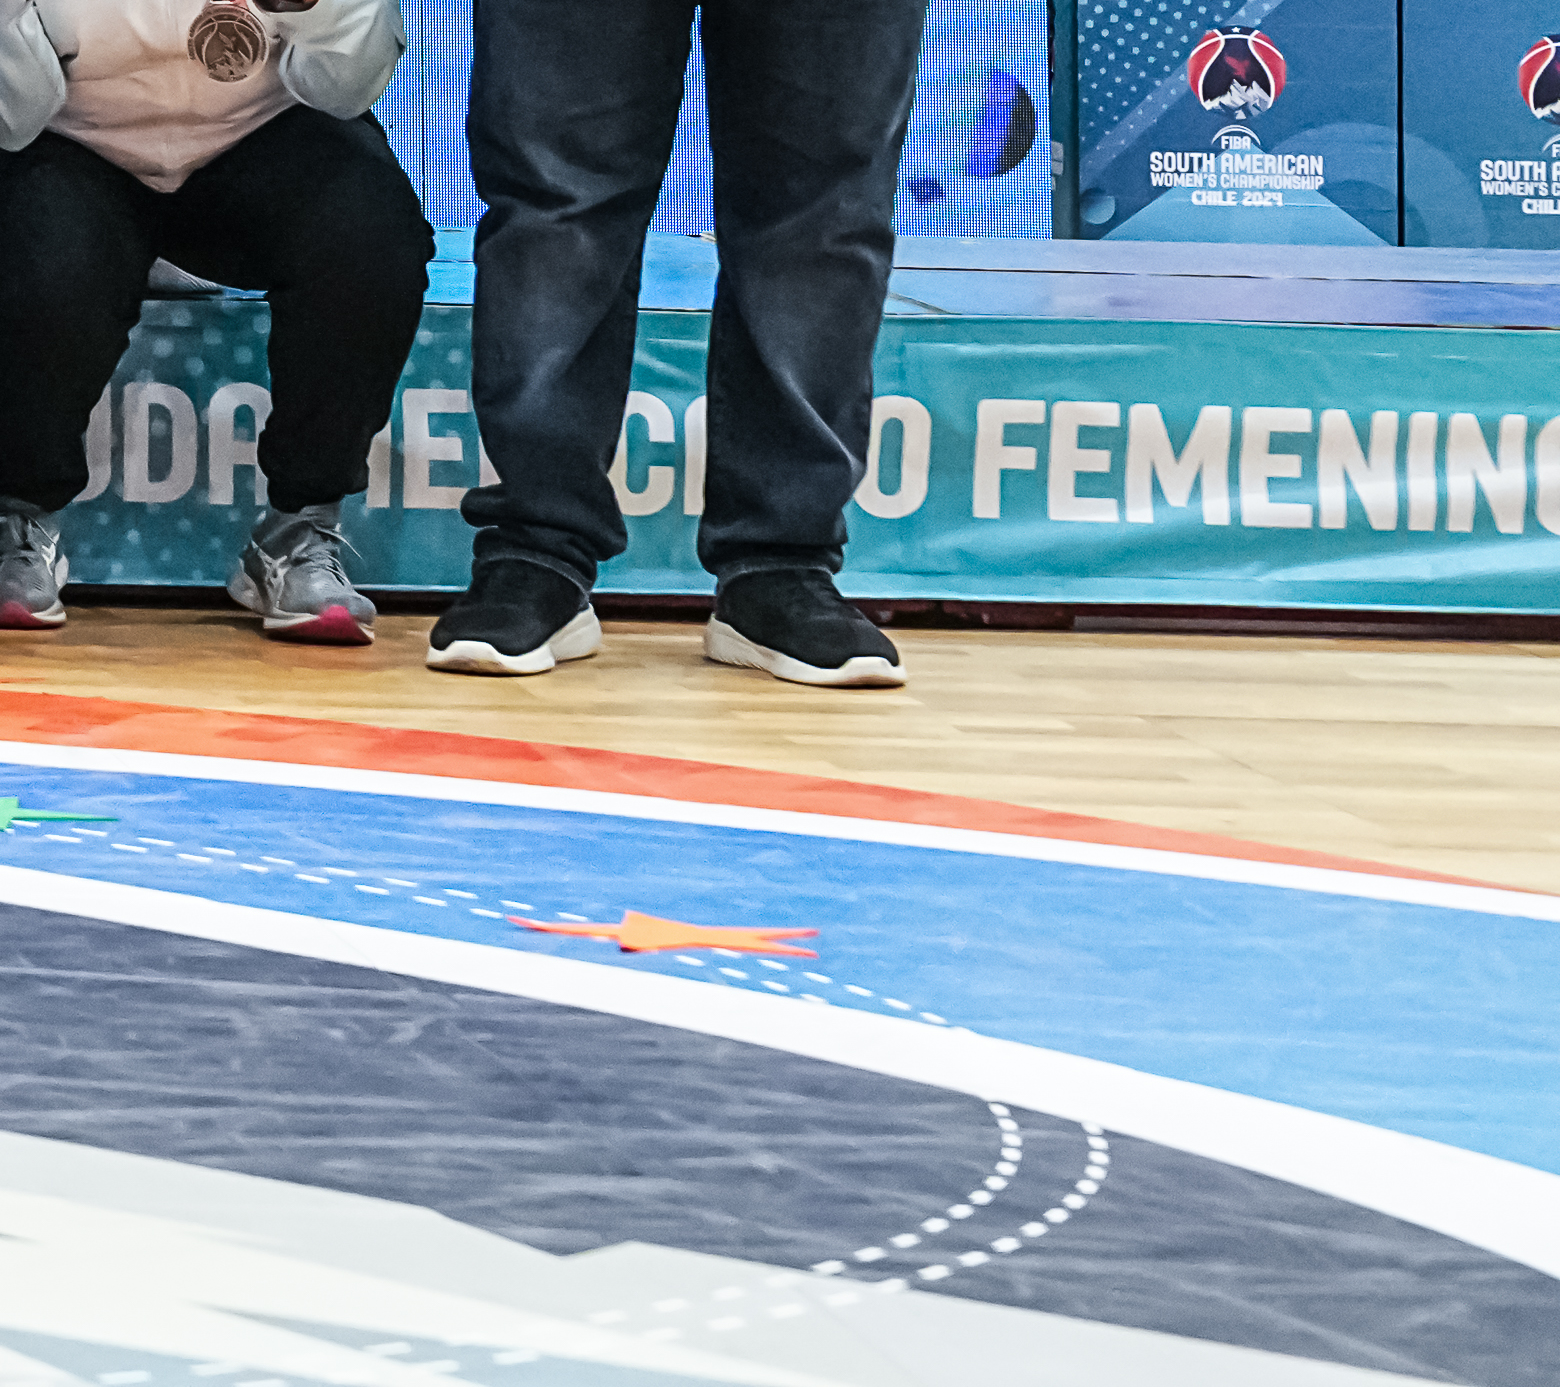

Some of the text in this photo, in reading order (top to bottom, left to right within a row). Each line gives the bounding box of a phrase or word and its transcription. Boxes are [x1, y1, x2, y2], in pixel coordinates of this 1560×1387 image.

[1220, 135, 1252, 149] FIBA
[1150, 151, 1324, 176] SOUTH AMERICAN
[1480, 161, 1547, 182] SOUTH
[1150, 172, 1325, 191] WOMEN'S CHAMPIONSHIP
[1480, 181, 1549, 197] WOMEN'S
[1191, 191, 1283, 207] CHILE 2024
[1521, 199, 1560, 215] CHIL
